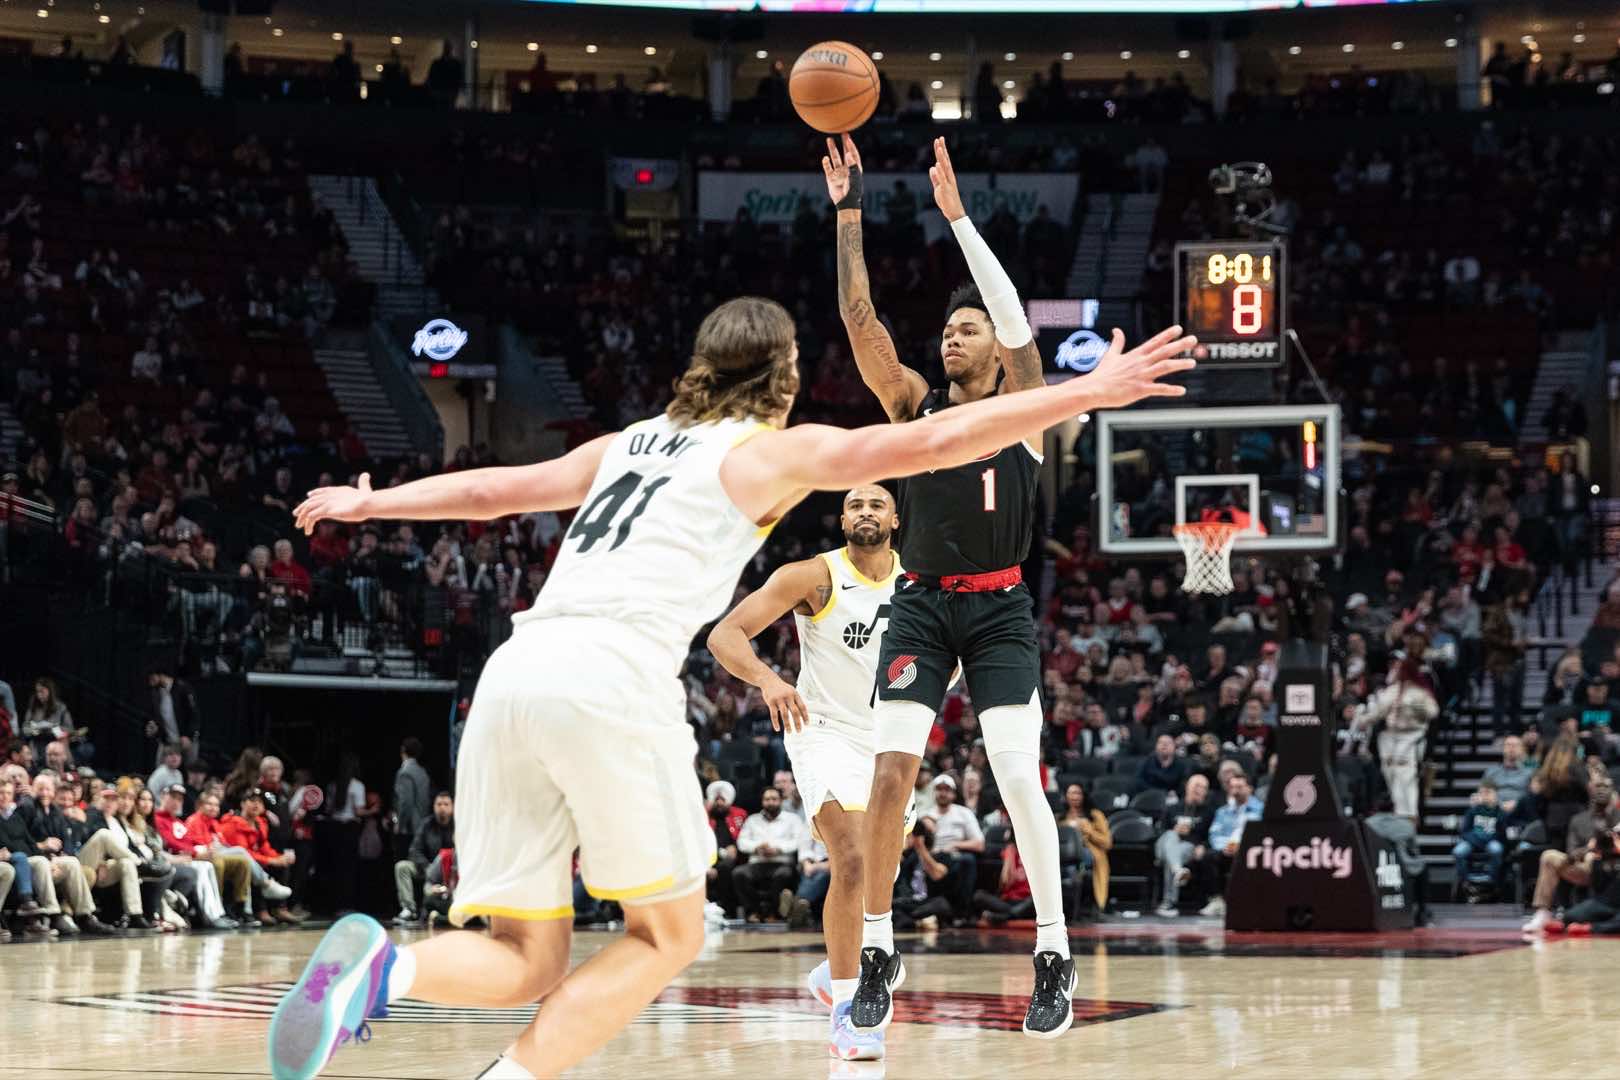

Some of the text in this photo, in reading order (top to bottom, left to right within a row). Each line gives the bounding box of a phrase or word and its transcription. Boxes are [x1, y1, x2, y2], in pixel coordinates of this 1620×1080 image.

[1207, 253, 1271, 284] 8:01
[1232, 284, 1262, 334] 8
[1207, 341, 1278, 359] TISSOT
[981, 467, 996, 512] 1
[567, 470, 673, 553] 41
[1246, 836, 1353, 878] ripcity
